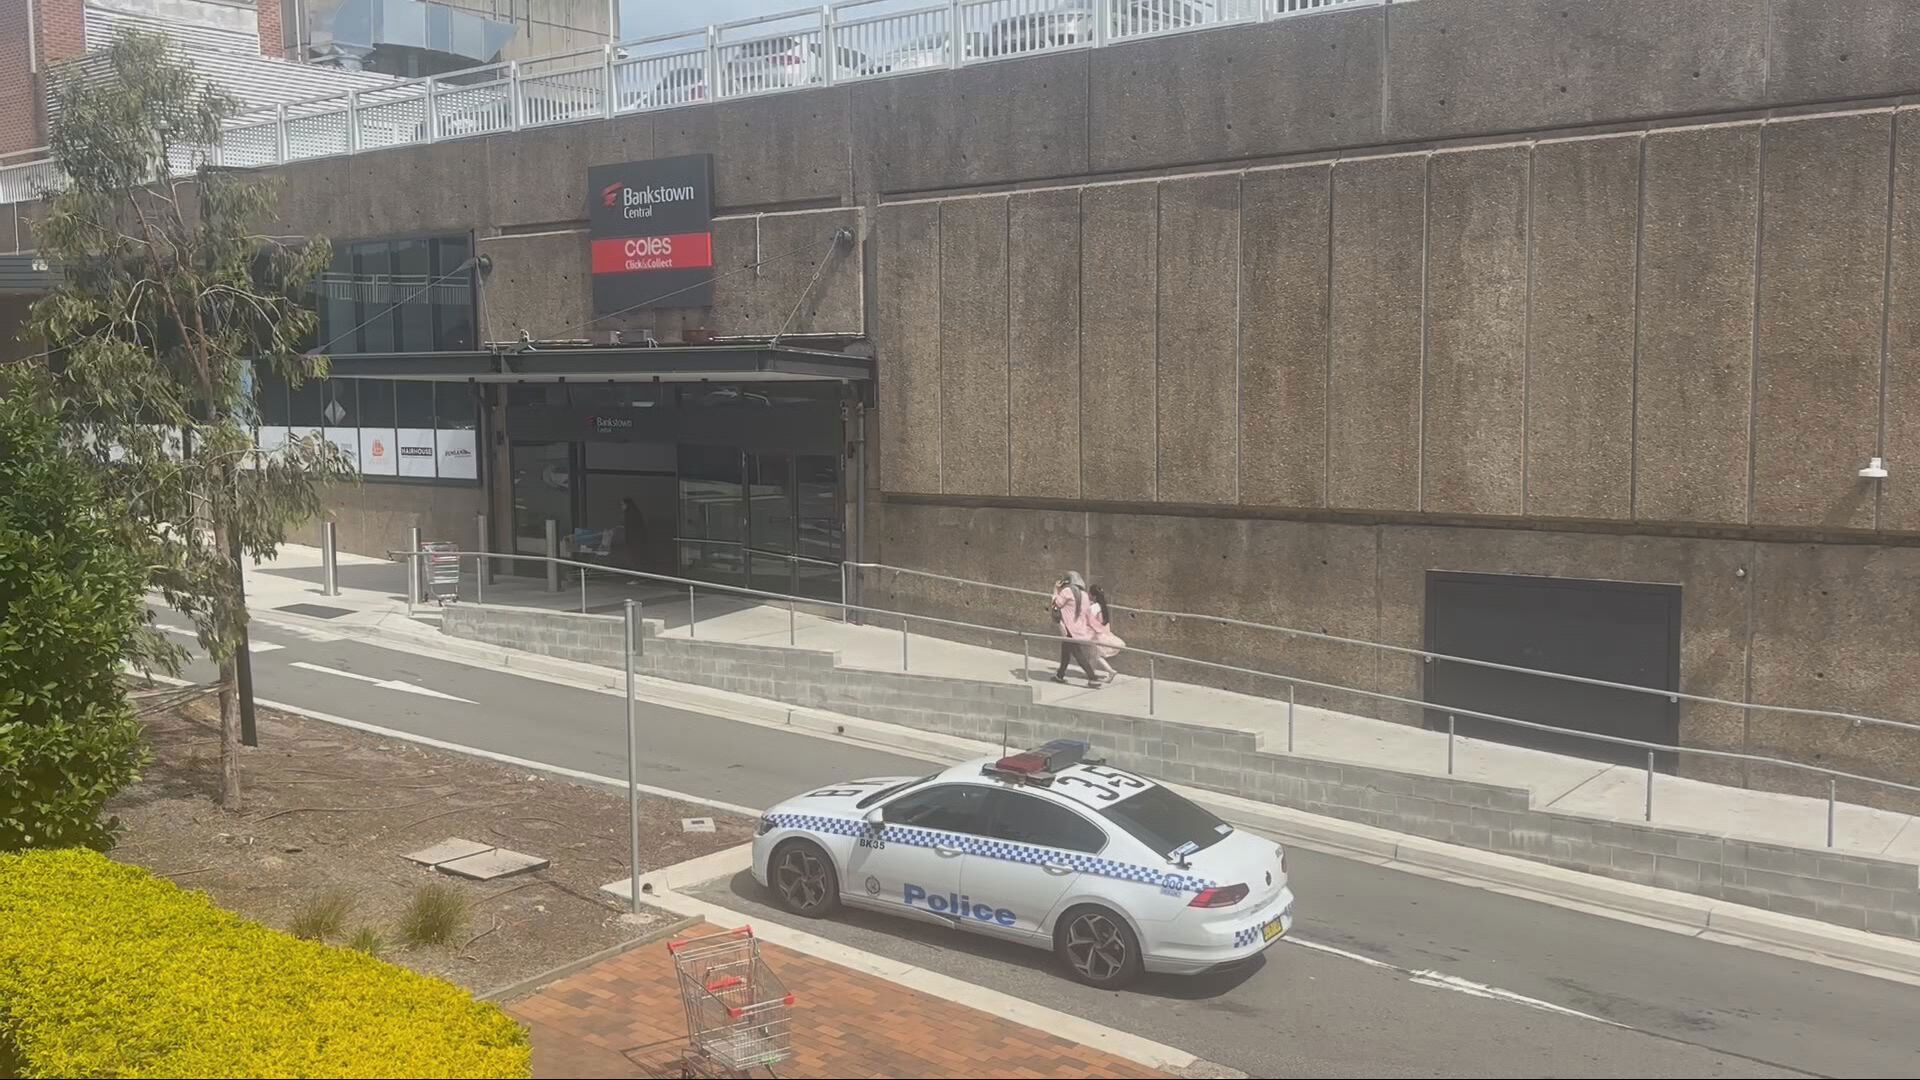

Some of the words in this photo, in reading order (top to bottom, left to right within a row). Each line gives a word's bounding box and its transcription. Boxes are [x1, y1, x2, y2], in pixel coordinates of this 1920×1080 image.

[623, 185, 695, 206] Bankstown
[623, 205, 653, 219] Central
[624, 237, 672, 257] coles
[625, 258, 673, 270] Click&Collect
[1056, 765, 1145, 801] 35
[859, 838, 885, 850] BK35
[904, 883, 1017, 926] Police
